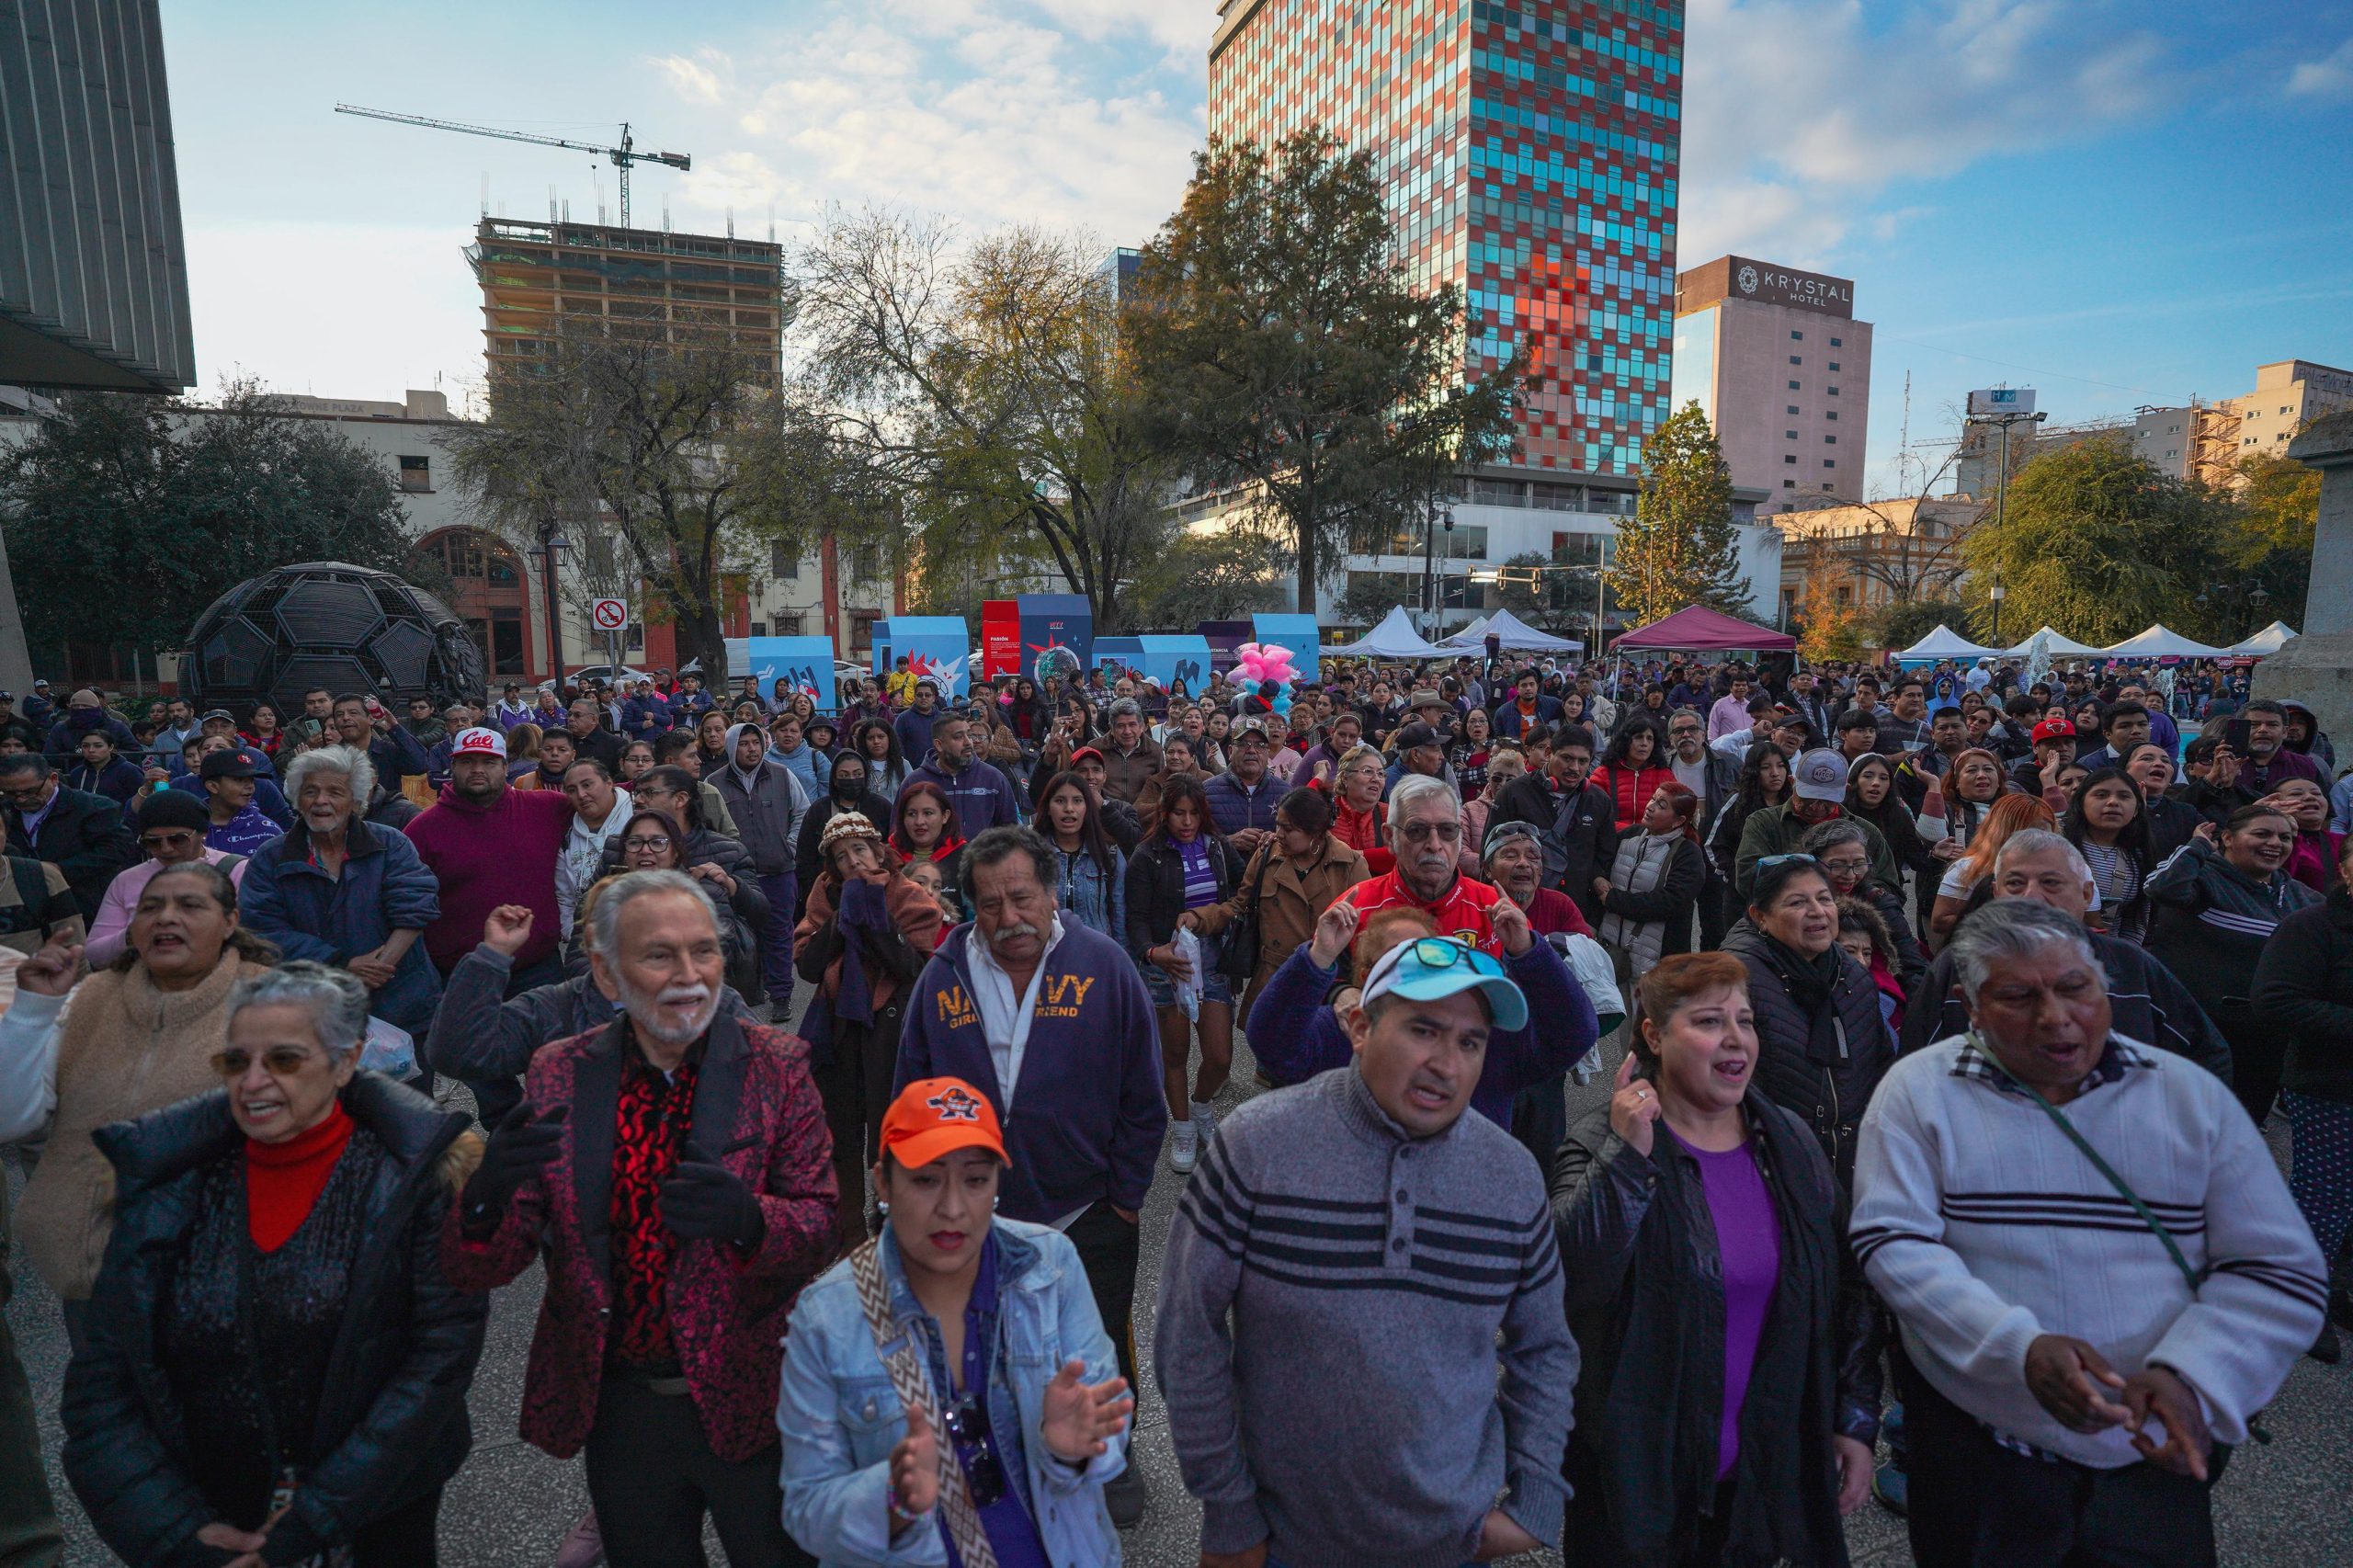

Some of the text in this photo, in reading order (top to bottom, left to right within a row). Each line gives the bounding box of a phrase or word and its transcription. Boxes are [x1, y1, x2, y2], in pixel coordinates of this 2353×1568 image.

[1764, 272, 1849, 302] KRYSTAL
[1790, 292, 1826, 307] HOTEL
[332, 403, 365, 414] PLAZA
[227, 832, 276, 843] Champion
